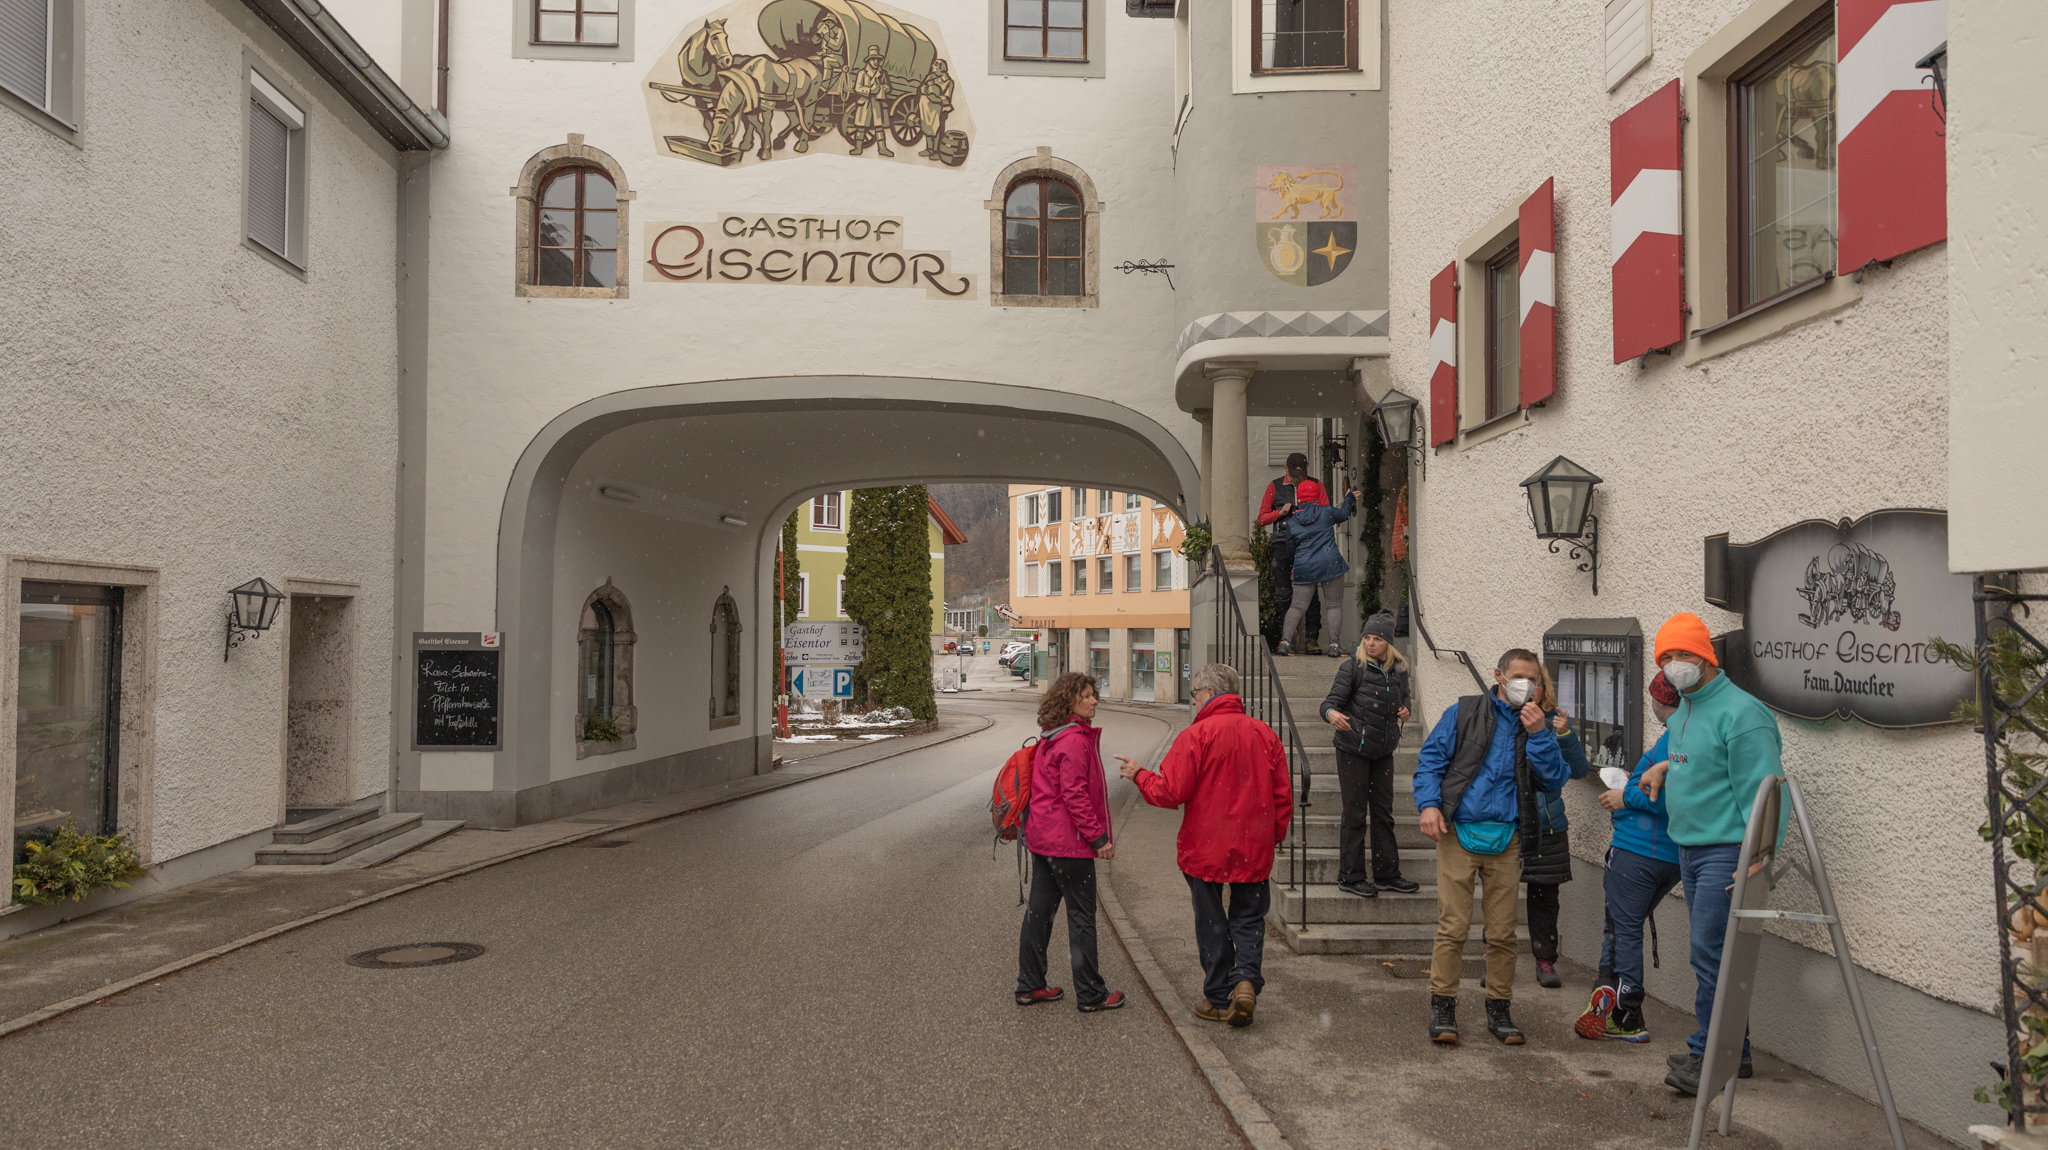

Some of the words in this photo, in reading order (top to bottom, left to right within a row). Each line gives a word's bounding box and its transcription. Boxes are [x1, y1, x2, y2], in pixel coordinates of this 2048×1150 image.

[722, 216, 901, 241] GASTHOF
[1031, 619, 1056, 628] TRAFIK
[790, 625, 826, 637] Gasthof
[785, 637, 832, 648] Eisentor
[1754, 641, 1829, 660] GASTHOF
[421, 659, 448, 677] Rosa
[461, 683, 469, 692] in
[837, 672, 850, 693] P
[435, 714, 444, 726] mit
